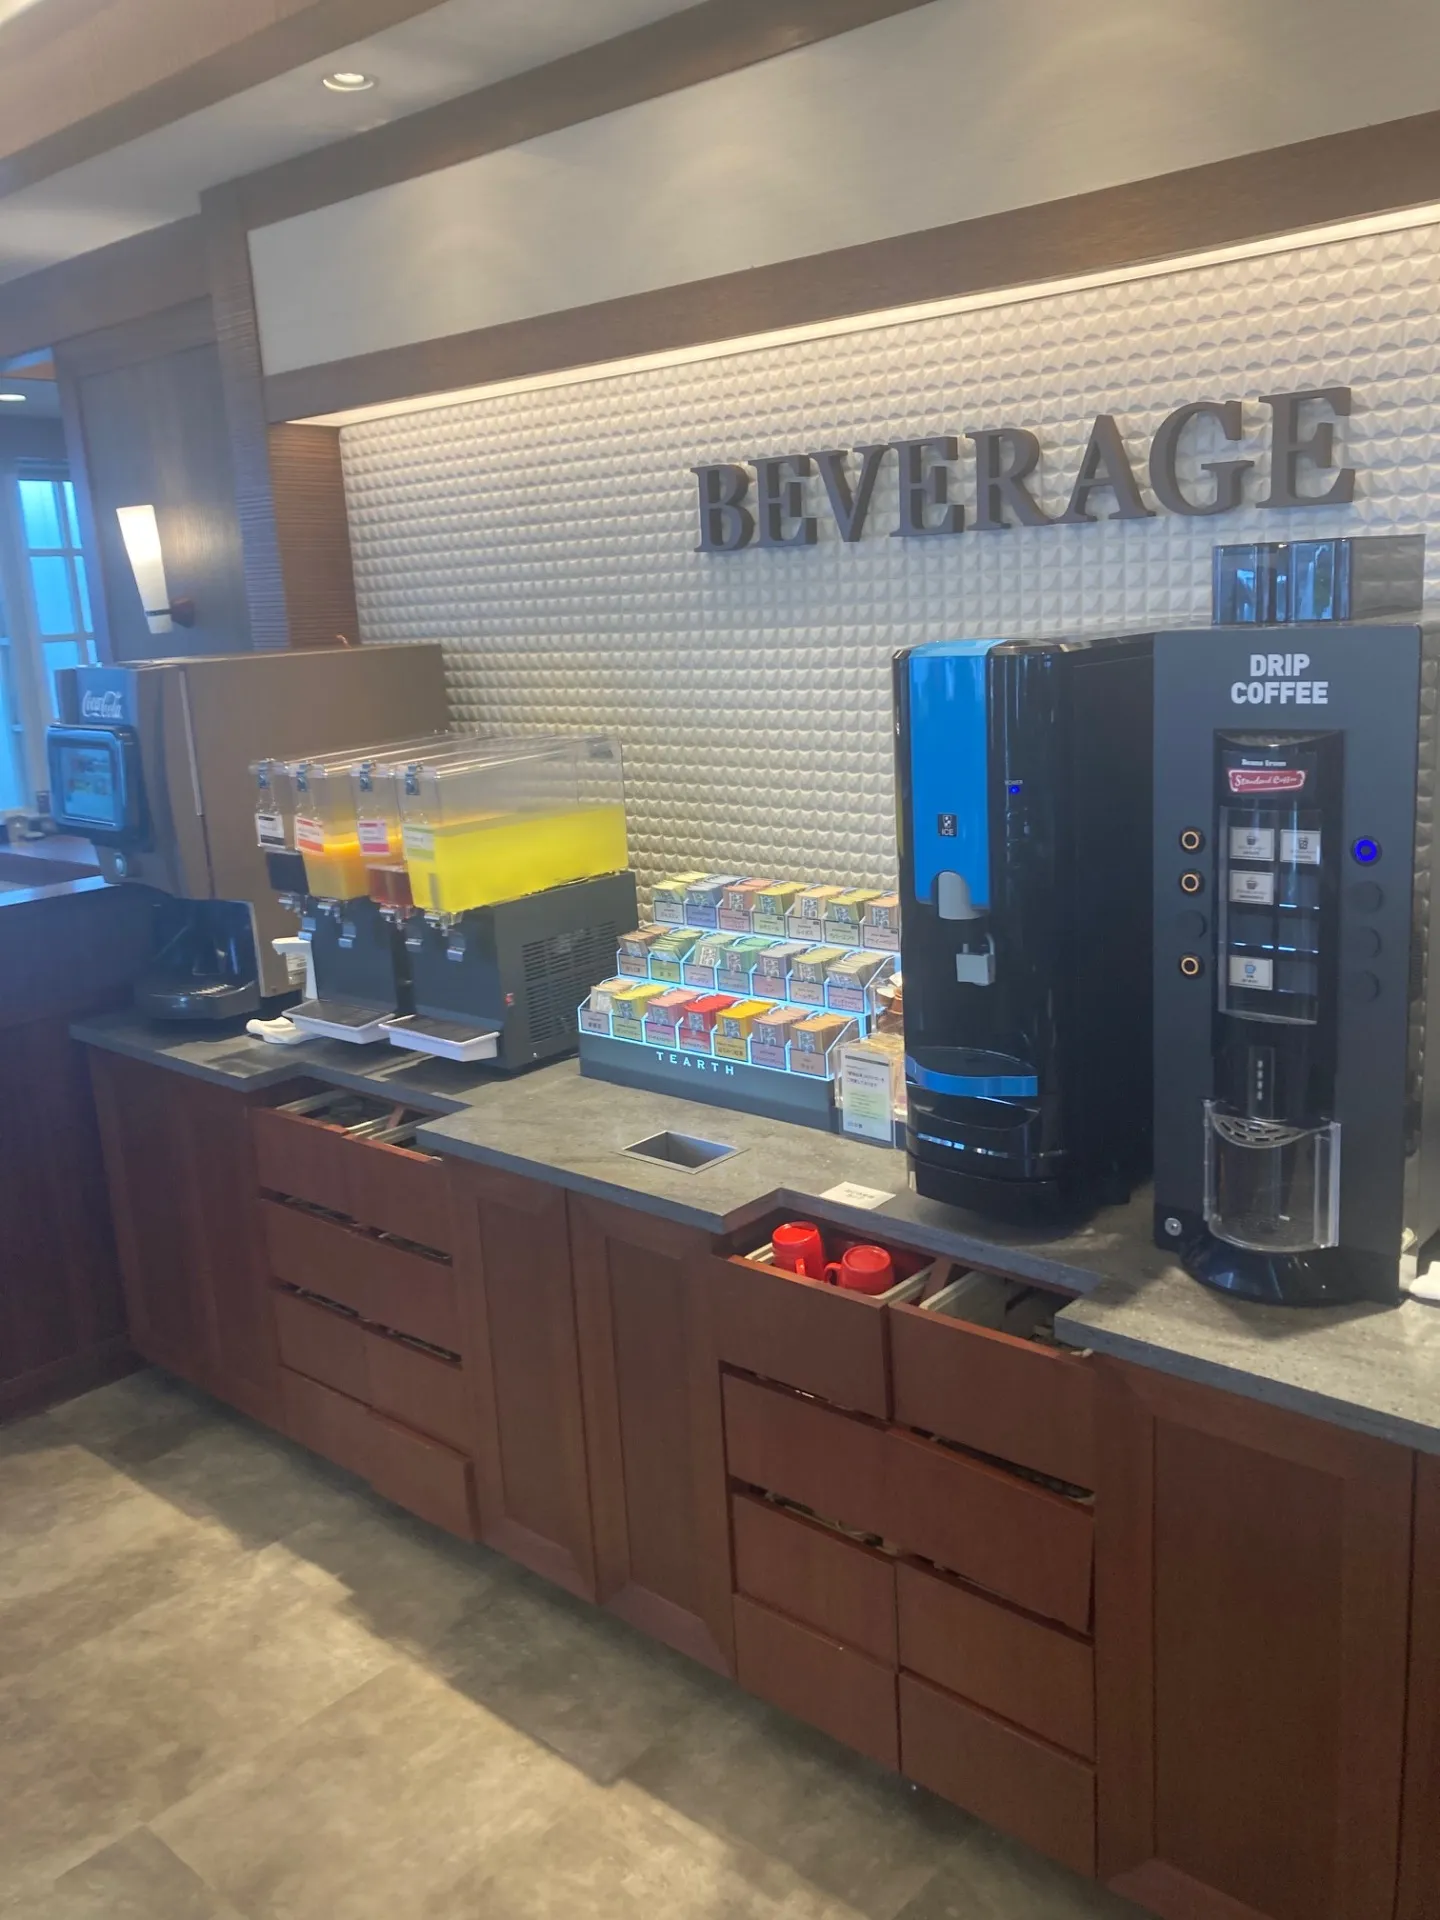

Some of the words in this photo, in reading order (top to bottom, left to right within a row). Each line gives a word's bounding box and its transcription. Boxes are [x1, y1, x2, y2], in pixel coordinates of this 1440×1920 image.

[690, 386, 1355, 553] BEVERAGE
[1250, 653, 1310, 677] DRIP
[1231, 681, 1329, 704] COFFEE
[941, 828, 954, 836] ICE
[656, 1051, 734, 1075] TEARTH
